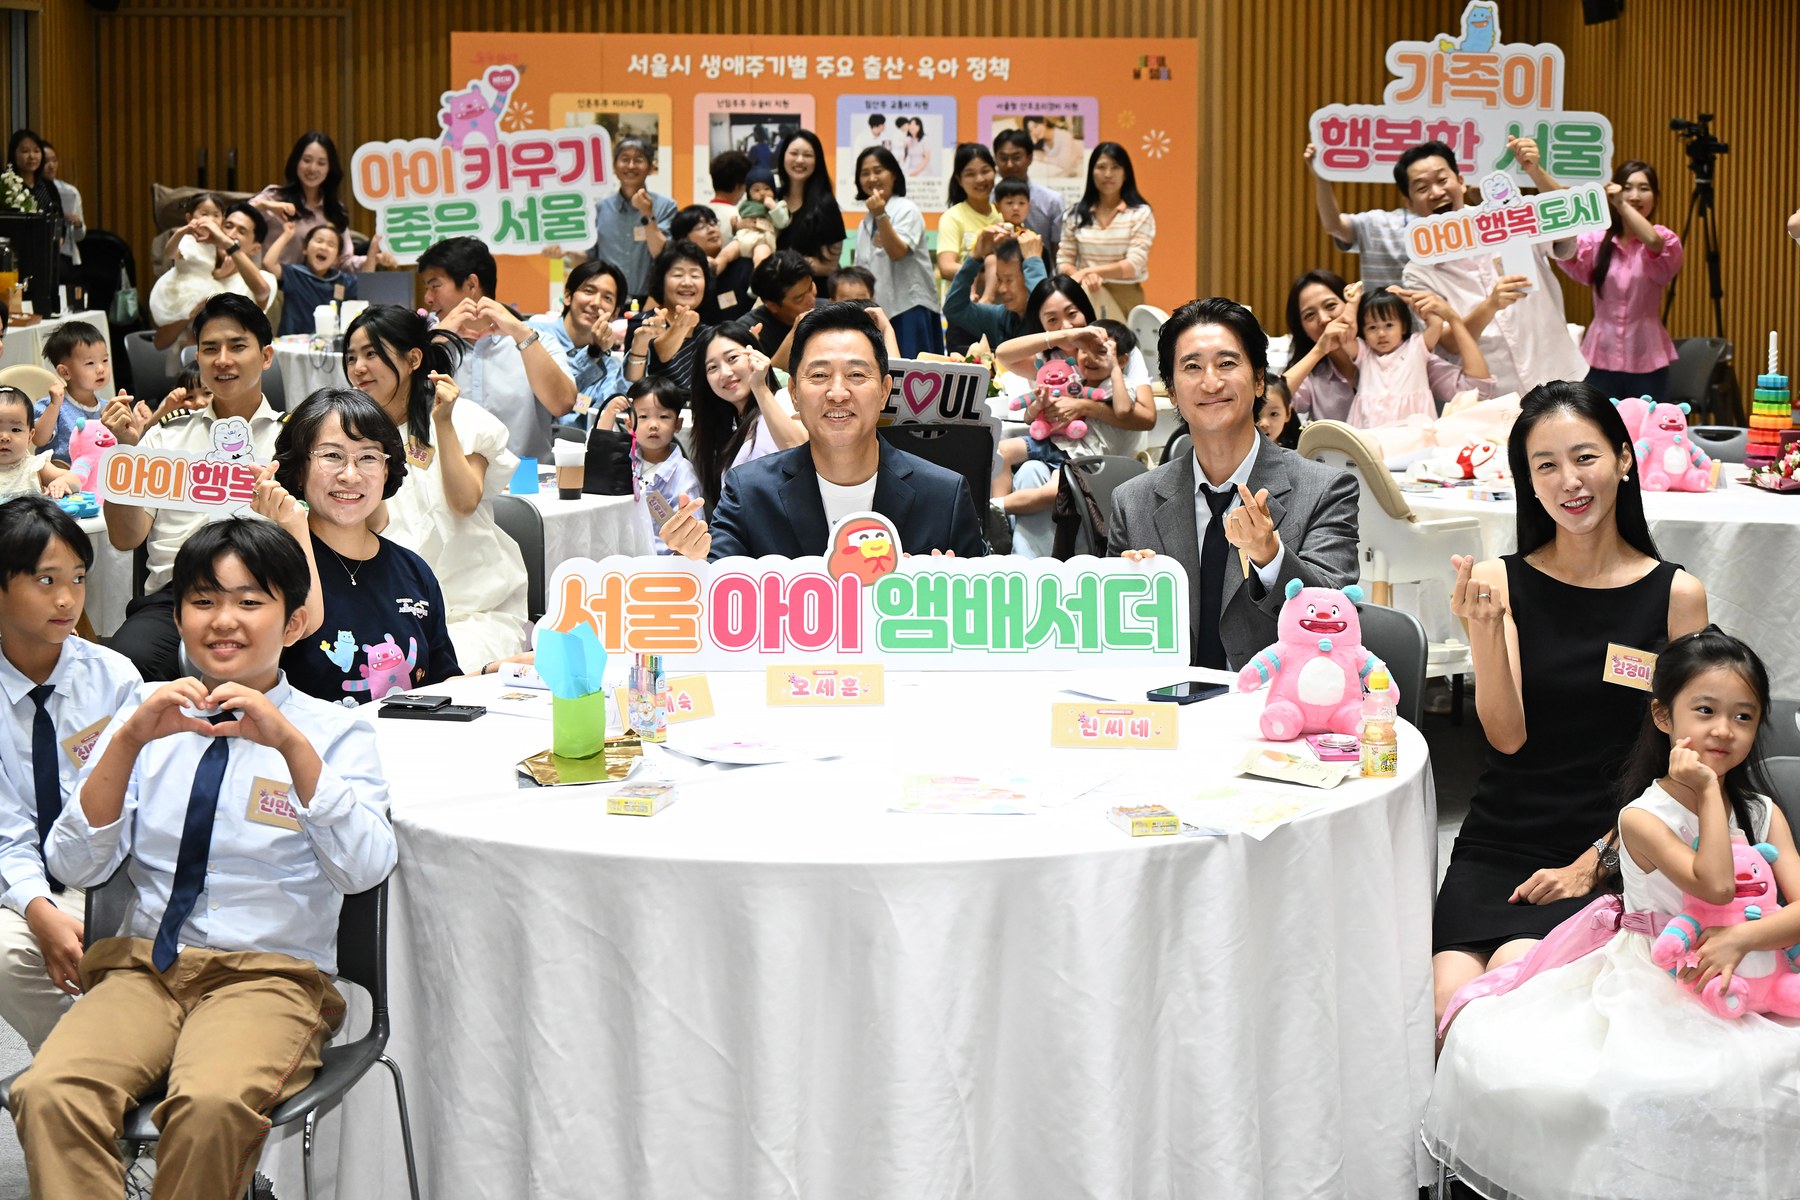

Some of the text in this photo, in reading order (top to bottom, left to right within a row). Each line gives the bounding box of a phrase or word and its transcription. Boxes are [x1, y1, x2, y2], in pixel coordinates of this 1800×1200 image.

[627, 53, 1011, 82] 서울시 생애주기별 주요 출산·육아 정책
[1393, 51, 1556, 109] 가족이
[358, 134, 607, 200] 아이 키우기
[1318, 115, 1606, 180] 행복한 서울
[385, 191, 589, 254] 좋은 서울
[1411, 189, 1605, 258] 아이 행복 도시
[106, 452, 188, 502] 아이
[548, 571, 1179, 653] 서울 아이 앰배서더
[1611, 659, 1652, 681] 김경미
